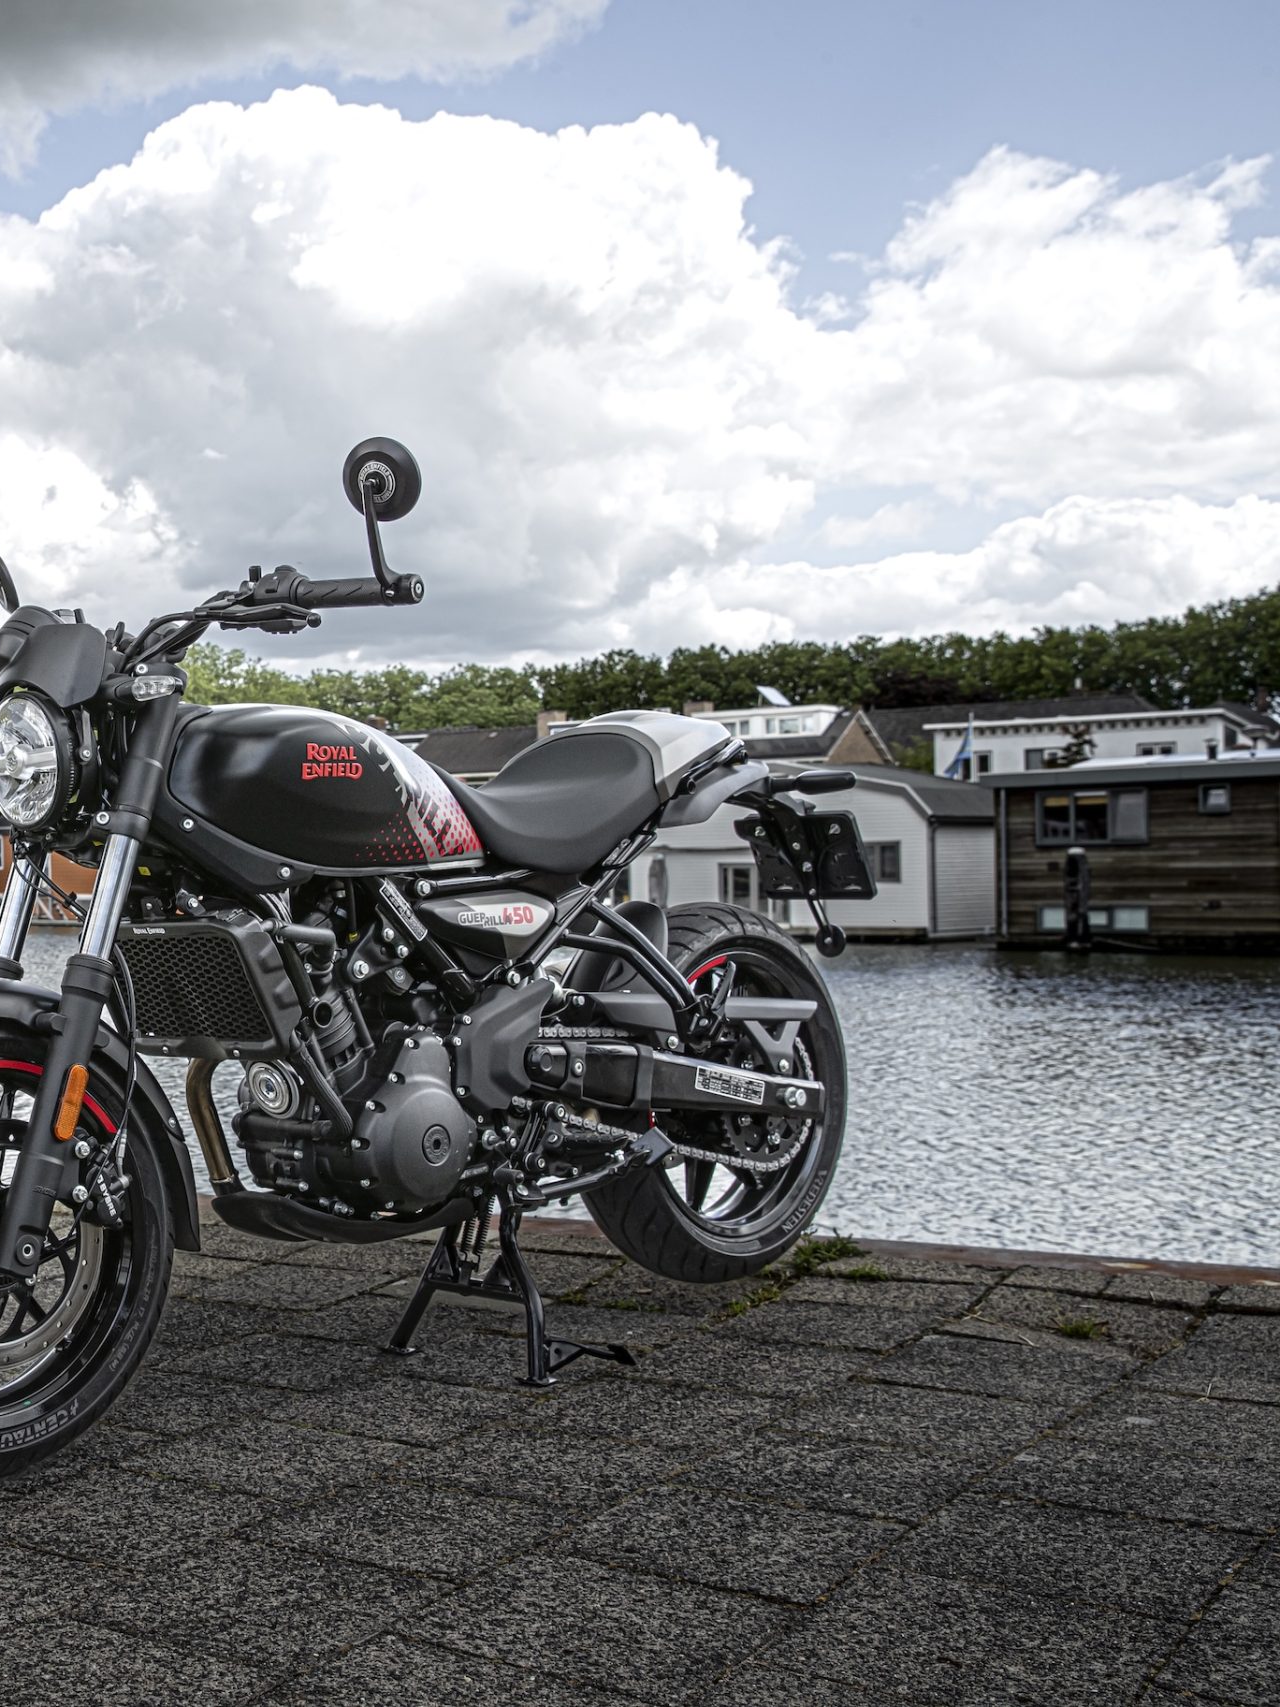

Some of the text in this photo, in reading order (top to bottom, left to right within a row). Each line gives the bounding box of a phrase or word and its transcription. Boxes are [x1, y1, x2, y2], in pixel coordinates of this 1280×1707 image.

[306, 743, 357, 761] ROYAL
[301, 763, 363, 780] ENFIELD
[502, 905, 534, 924] 450
[100, 1183, 116, 1217] BYBRE
[781, 1170, 828, 1233] VREDESTEIN
